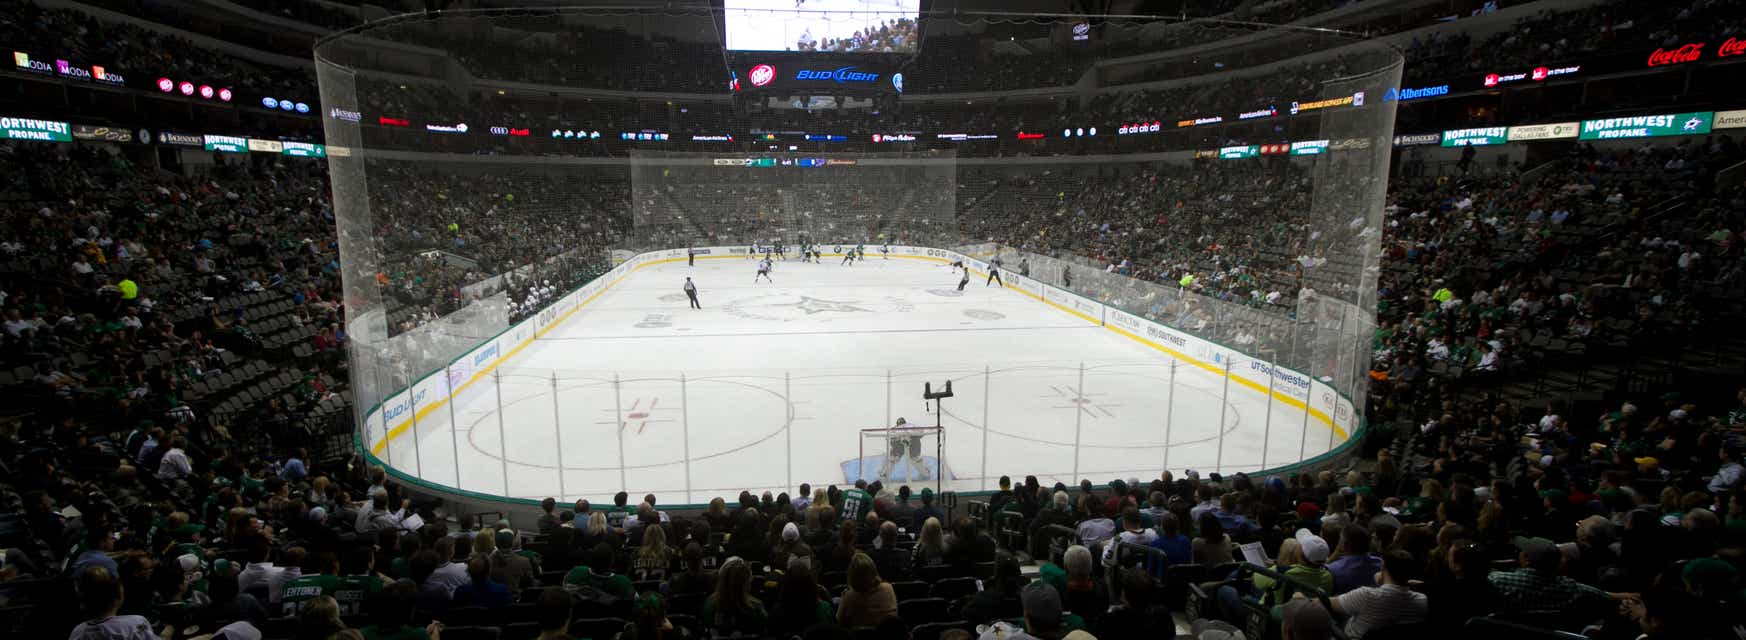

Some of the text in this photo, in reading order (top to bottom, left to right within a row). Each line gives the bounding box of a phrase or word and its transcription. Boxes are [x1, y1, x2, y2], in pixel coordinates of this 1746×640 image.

[61, 65, 91, 78] MODIA
[796, 70, 880, 81] BUD LIGHT
[1400, 84, 1449, 100] Albertsons
[1584, 114, 1676, 133] NORTHWEST
[1718, 116, 1746, 126] Amer
[8, 129, 51, 140] PROPANE
[510, 128, 530, 136] Audi
[1445, 126, 1507, 140] NORTHWEST
[1598, 128, 1648, 138] PROPANE
[204, 134, 246, 148] NORTHWEST
[758, 246, 792, 254] GEIO
[1158, 330, 1186, 347] SOUTHWEST
